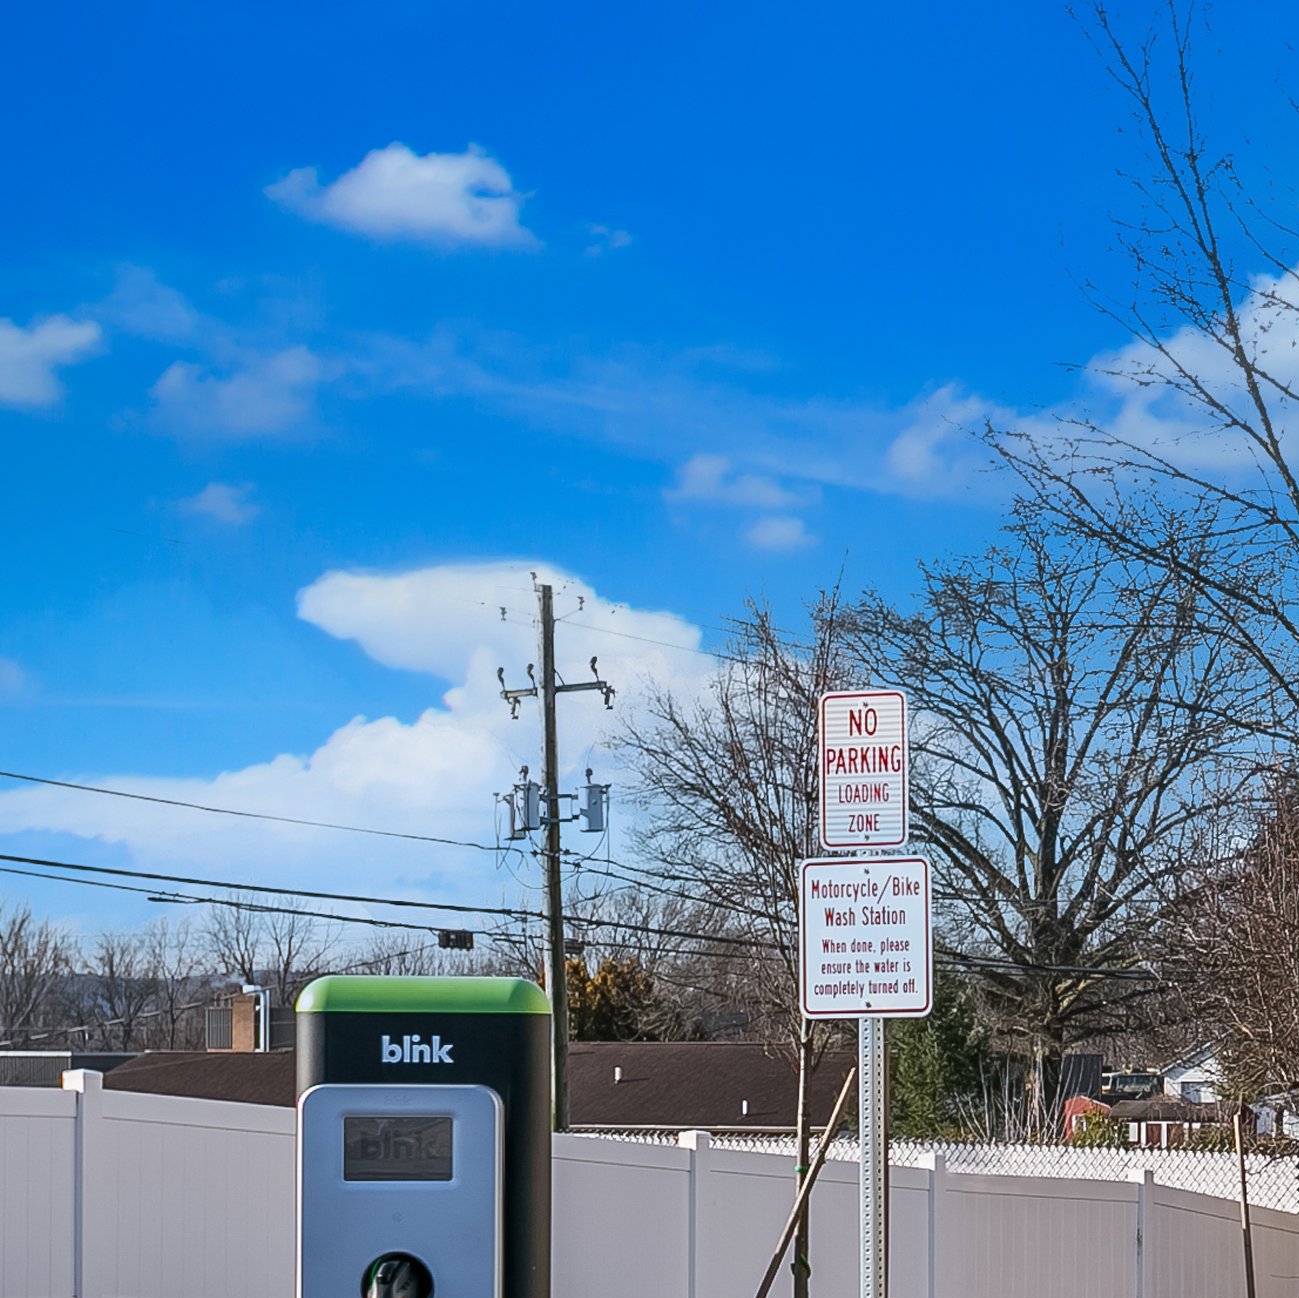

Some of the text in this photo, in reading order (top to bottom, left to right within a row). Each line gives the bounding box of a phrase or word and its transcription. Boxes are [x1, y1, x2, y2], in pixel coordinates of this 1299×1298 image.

[849, 708, 877, 736] NO
[826, 745, 901, 775] PARKING
[838, 783, 889, 803] LOADING
[848, 814, 881, 832] ZONE
[811, 875, 920, 904] Motorcycle/Bike
[824, 906, 906, 927] Wash Station
[822, 939, 847, 953] When
[880, 936, 910, 955] please
[821, 957, 911, 974] ensure the water is
[814, 975, 918, 998] completely turned off.
[381, 1035, 454, 1064] blink
